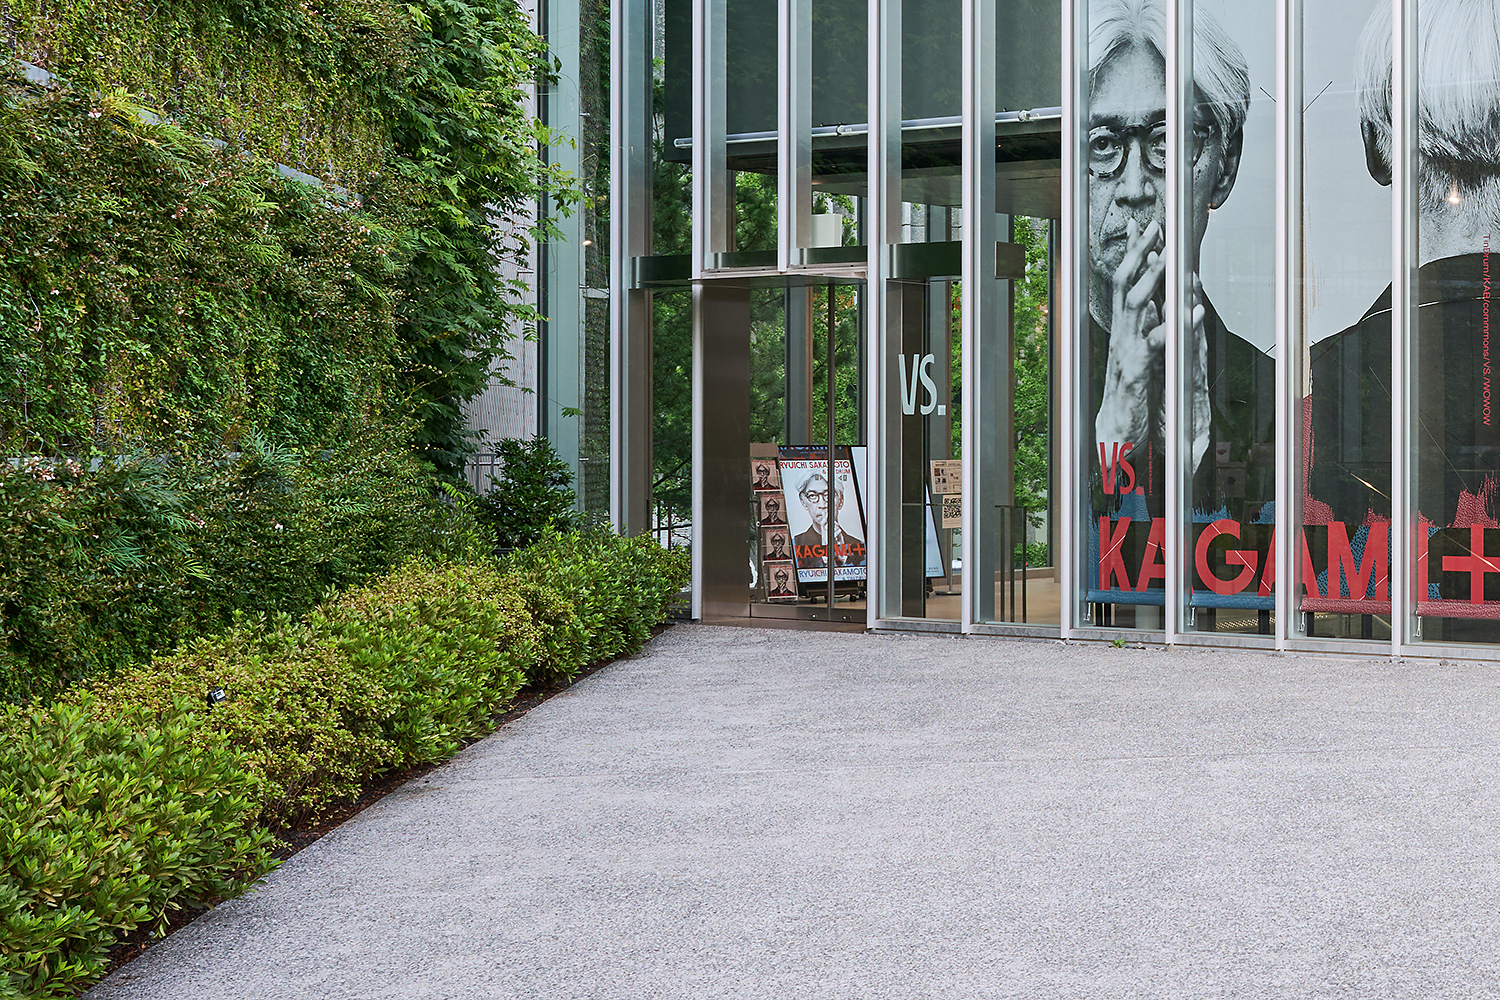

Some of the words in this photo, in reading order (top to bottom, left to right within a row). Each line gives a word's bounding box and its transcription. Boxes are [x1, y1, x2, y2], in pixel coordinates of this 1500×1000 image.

[898, 353, 947, 416] VS.
[808, 460, 850, 469] SAKAOTO
[1099, 441, 1144, 496] VS.
